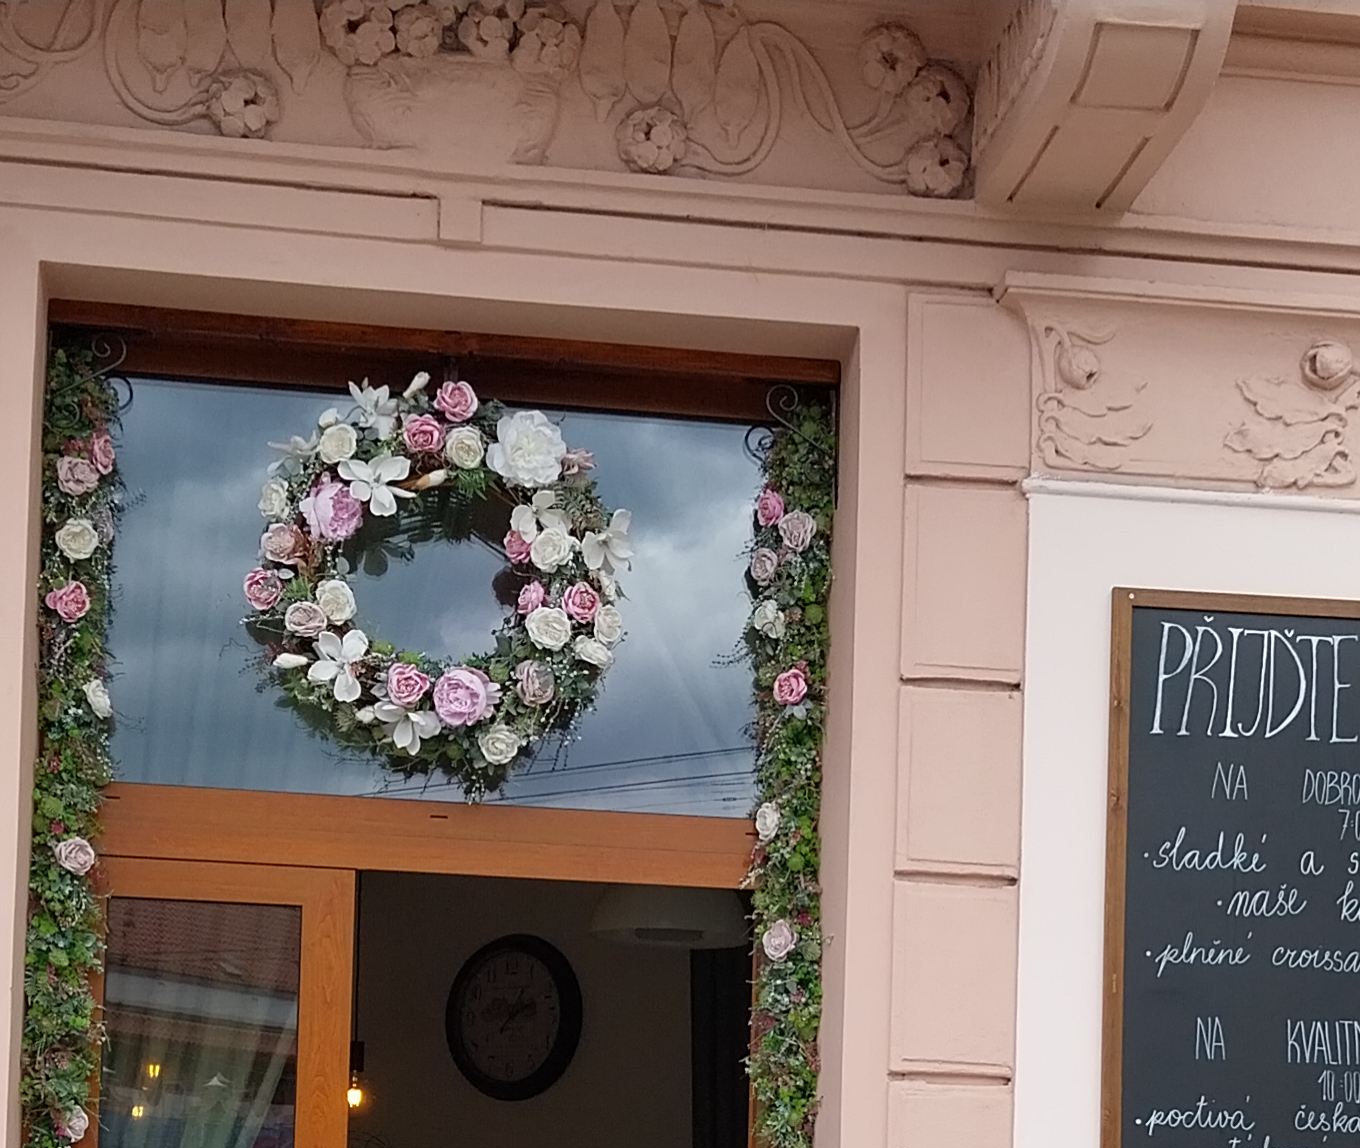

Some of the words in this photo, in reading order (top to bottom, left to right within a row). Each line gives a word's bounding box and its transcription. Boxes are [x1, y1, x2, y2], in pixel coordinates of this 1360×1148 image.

[1149, 616, 1359, 744] PŘIJĎTE
[1211, 761, 1249, 801] NA
[1153, 827, 1267, 873] sladké
[1300, 849, 1325, 876] a
[1227, 883, 1307, 917] naše
[1156, 931, 1253, 977] plněné
[1195, 1016, 1226, 1061] NA
[1145, 1095, 1255, 1135] poctivá
